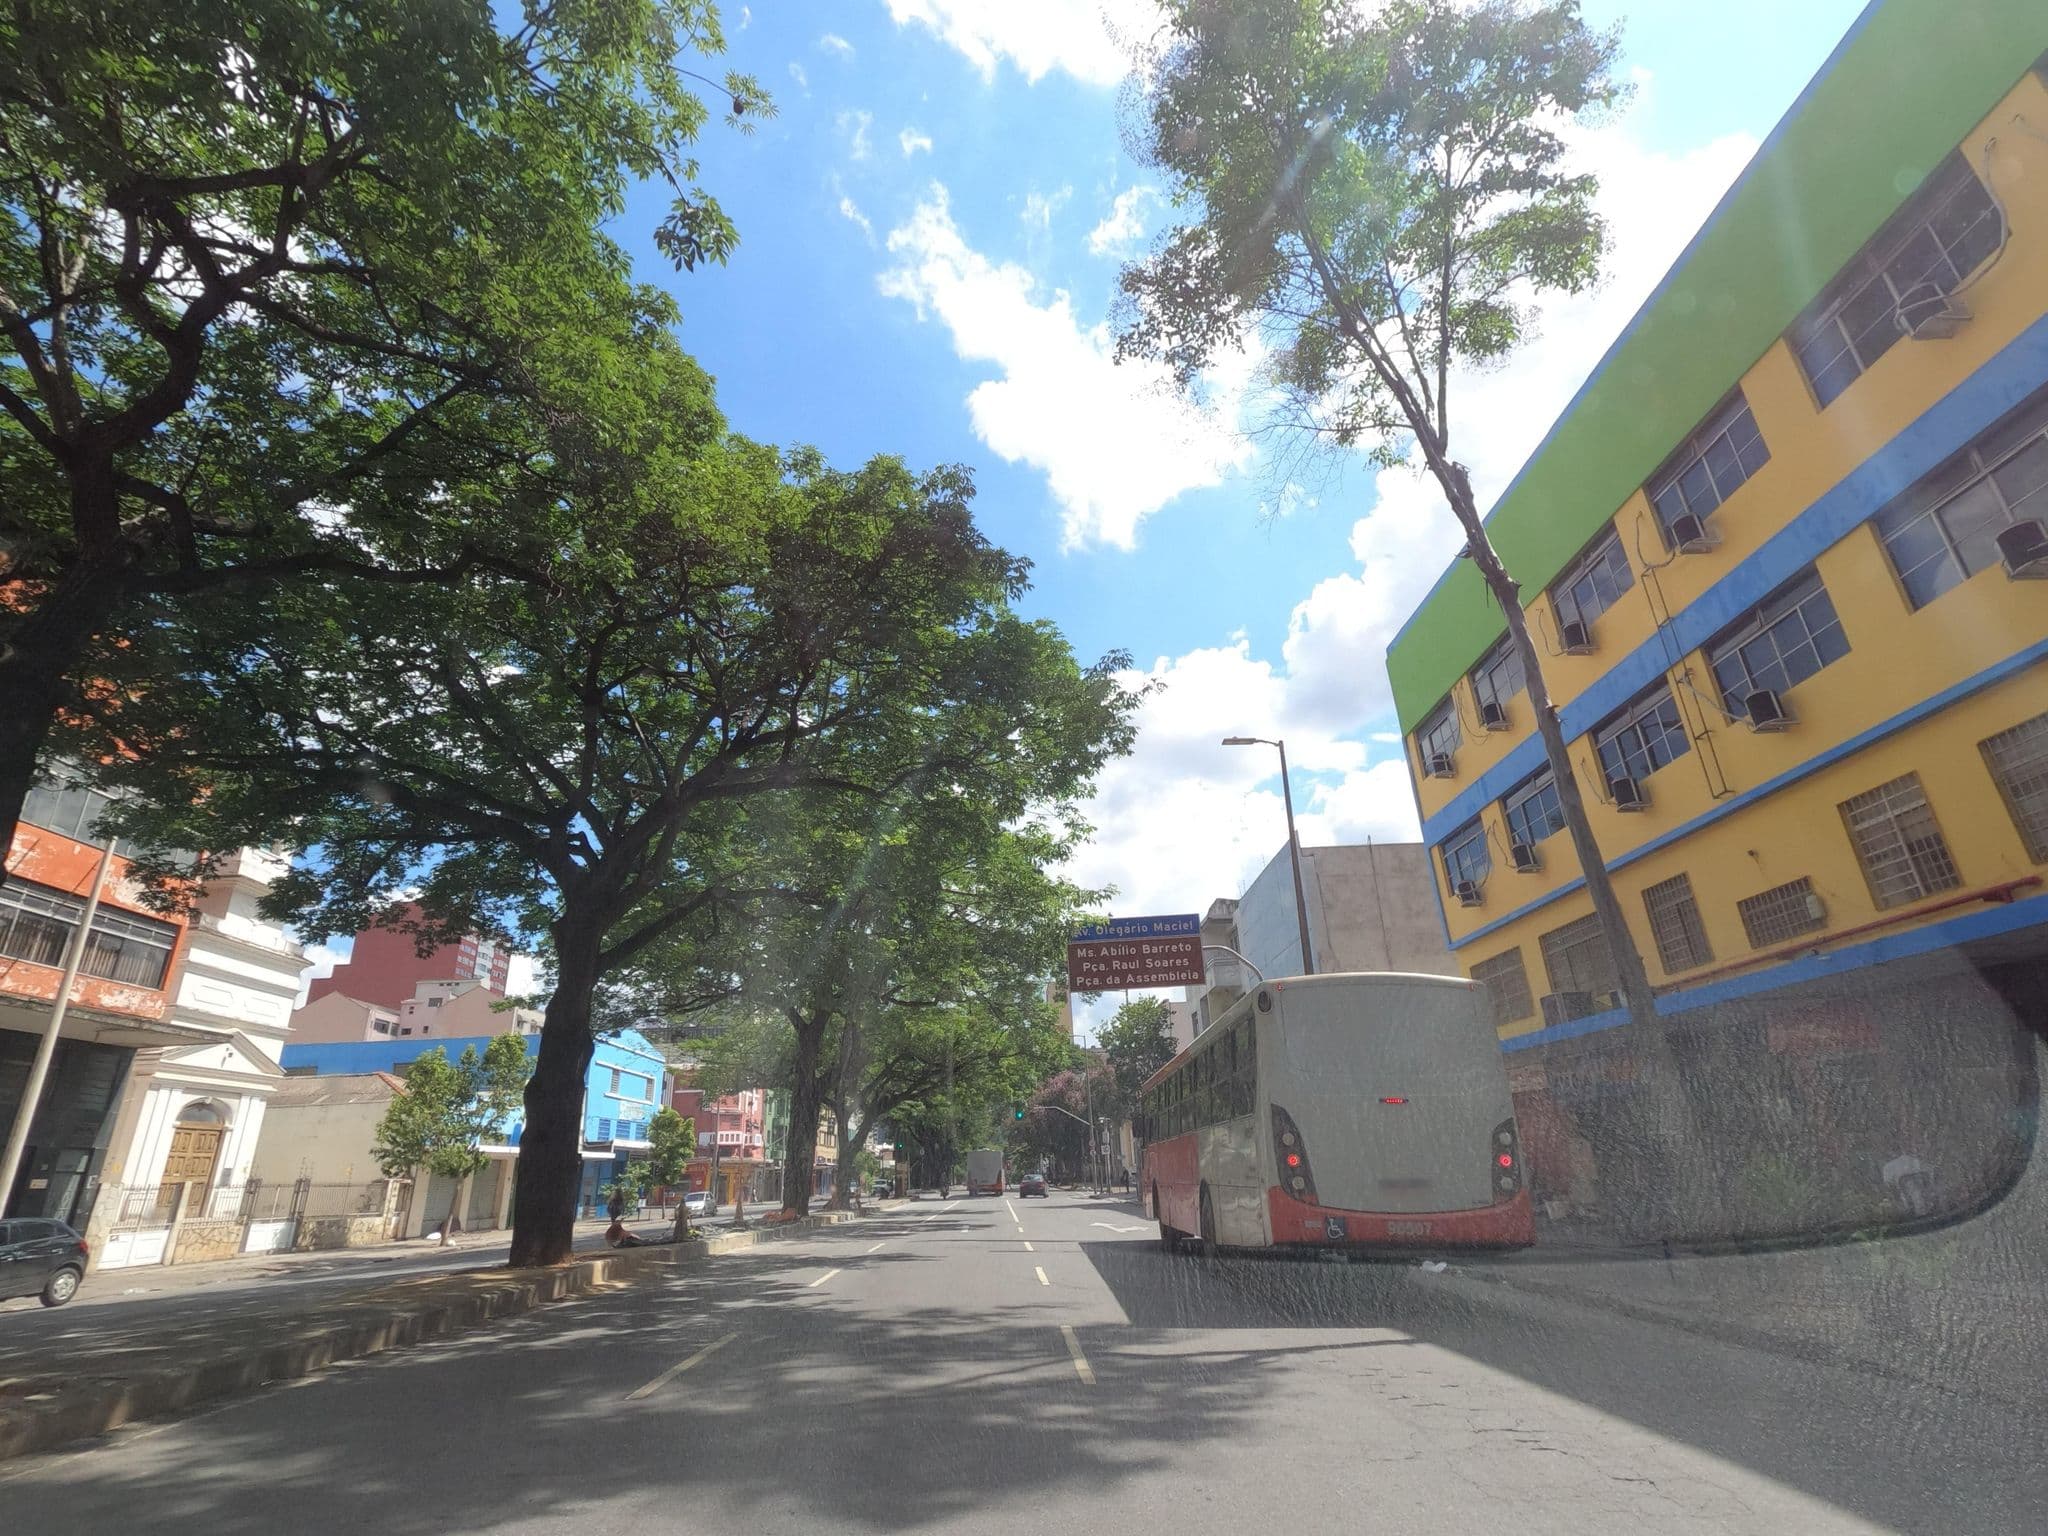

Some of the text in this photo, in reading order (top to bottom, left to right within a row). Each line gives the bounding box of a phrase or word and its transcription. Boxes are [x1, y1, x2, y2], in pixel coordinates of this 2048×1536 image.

[1096, 920, 1148, 937] Olegário
[1153, 920, 1193, 931] Maciel
[1077, 942, 1192, 958] Ms. Abílio Barreto
[1083, 958, 1189, 972] Pça. Raul Soares
[1076, 970, 1199, 987] Pça. da Assembleia
